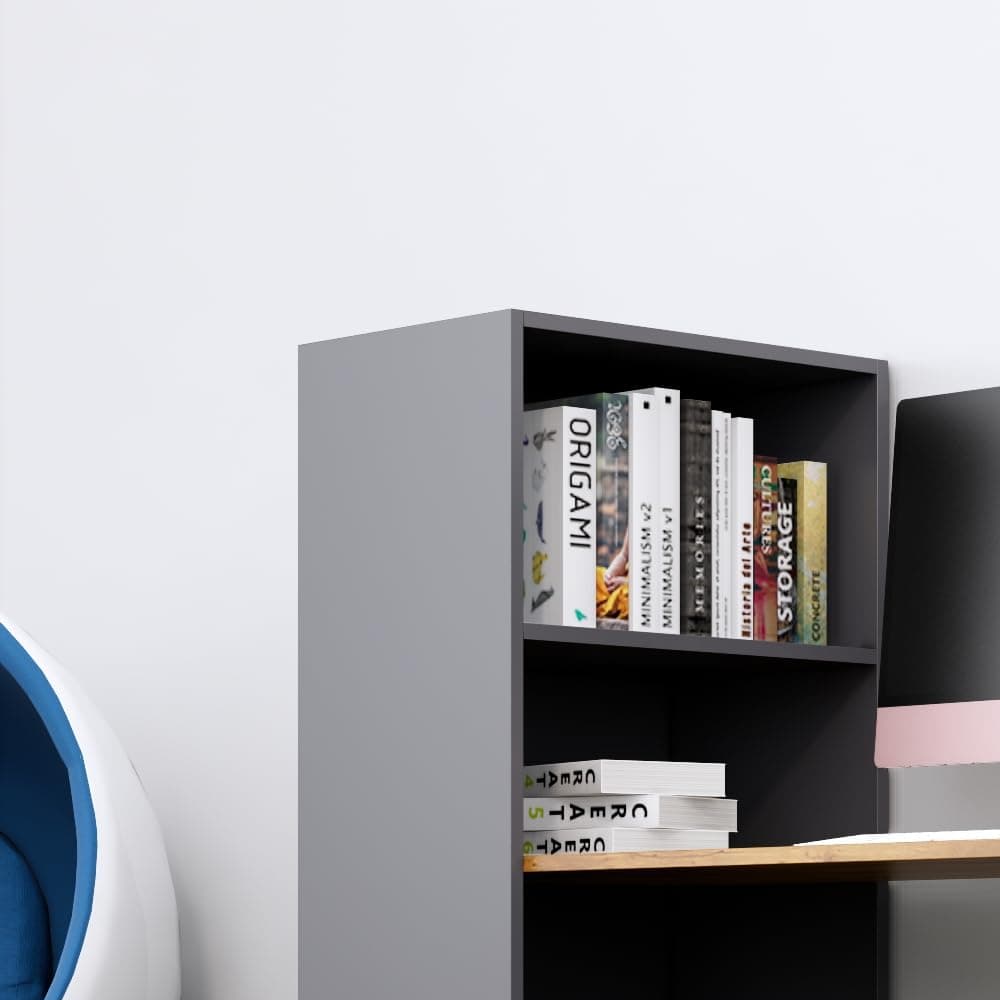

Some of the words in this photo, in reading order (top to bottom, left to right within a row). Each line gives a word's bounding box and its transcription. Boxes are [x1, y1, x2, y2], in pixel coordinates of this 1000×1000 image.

[569, 418, 592, 549] ORIGAMI
[640, 502, 652, 522] v2
[760, 465, 773, 555] CULTURES
[640, 527, 651, 628] MINIMALISM
[662, 529, 673, 628] MINIMALISM
[695, 496, 705, 612] MEMORIES
[777, 502, 793, 623] STORAGE
[811, 570, 821, 643] CONCRETE
